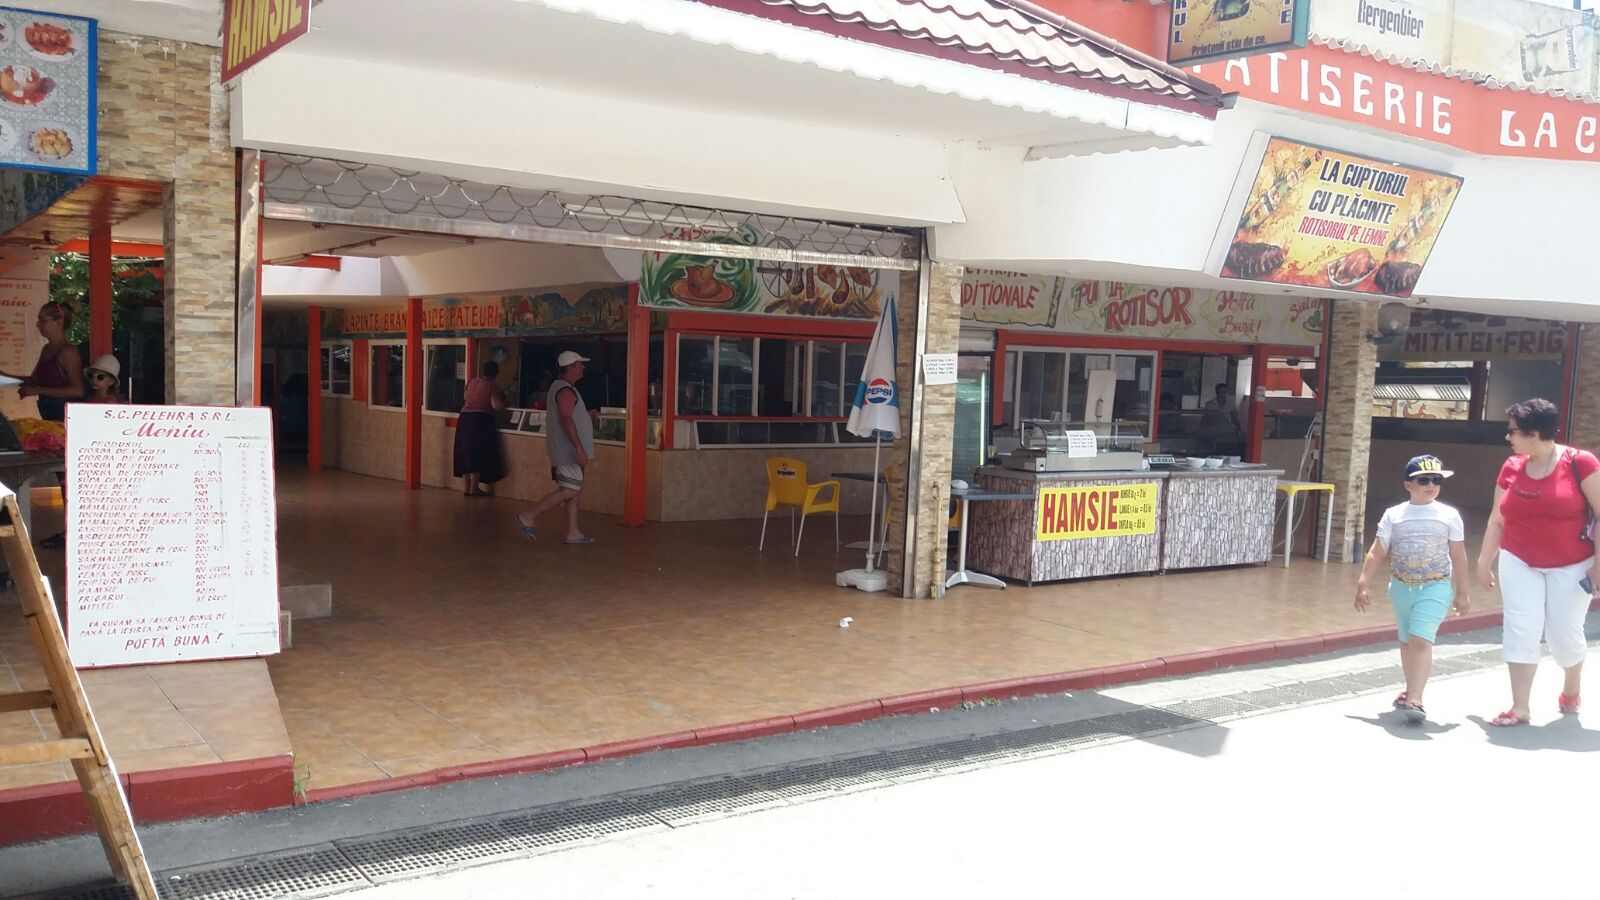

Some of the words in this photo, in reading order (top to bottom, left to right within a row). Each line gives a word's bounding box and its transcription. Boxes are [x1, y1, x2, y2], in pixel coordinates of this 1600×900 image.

[1358, 0, 1424, 38] Bergenbier
[1192, 53, 1452, 136] ATISERIE
[1319, 158, 1341, 183] LA
[1341, 164, 1409, 197] CUPTORUL
[1308, 189, 1333, 213] CU
[1330, 193, 1396, 225] PLĂCINTE
[1298, 216, 1348, 241] ROTISORUL
[1347, 224, 1362, 241] PE
[1358, 227, 1390, 247] LEMNE
[1077, 280, 1100, 308] PUI
[450, 304, 499, 328] PATEURI
[1404, 331, 1491, 352] MITITEI
[866, 388, 892, 396] PEPSI
[122, 422, 210, 437] Meniu
[1042, 491, 1119, 534] HAMSIE
[125, 637, 165, 650] POFTA
[174, 634, 210, 646] BUNA
